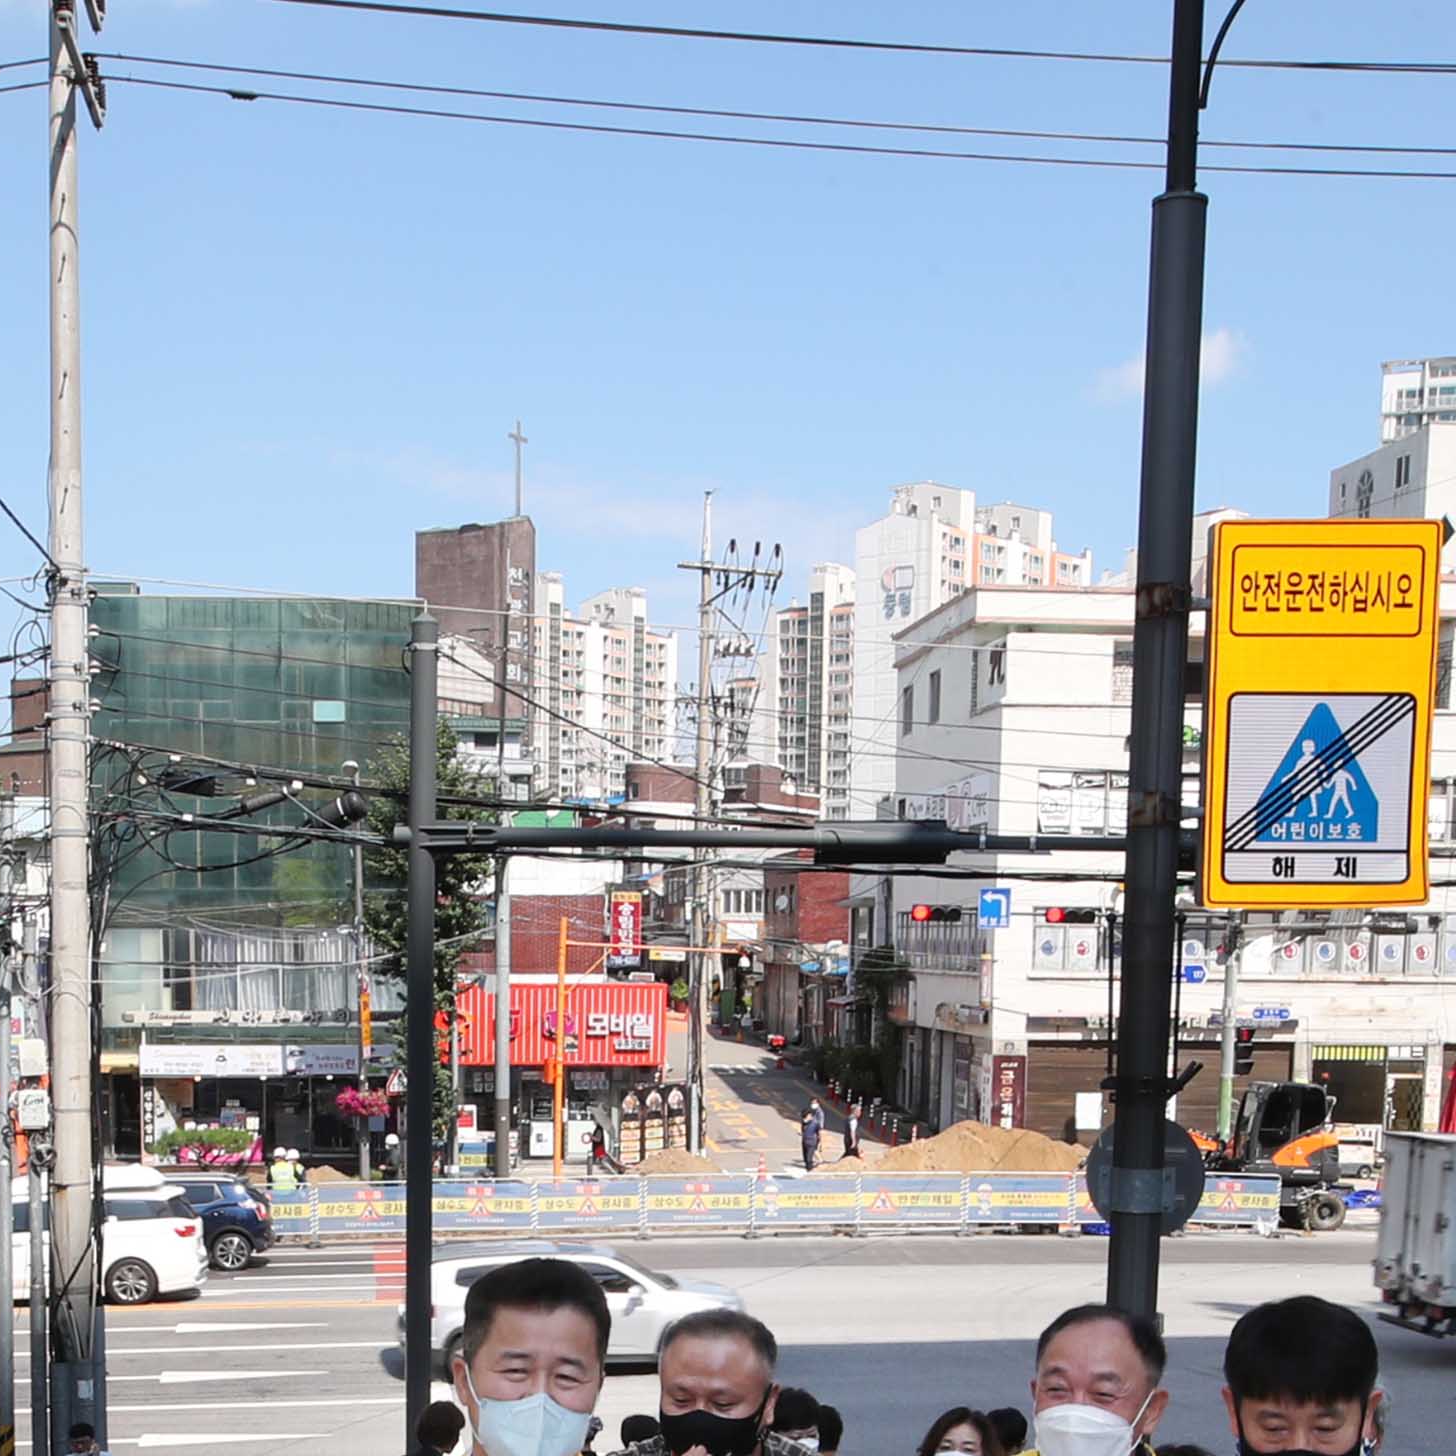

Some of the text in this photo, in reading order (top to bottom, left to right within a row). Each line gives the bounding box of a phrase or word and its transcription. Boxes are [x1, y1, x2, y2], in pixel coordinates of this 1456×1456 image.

[1240, 571, 1414, 613] 안전운전하십시오
[1271, 822, 1363, 840] 어린이보호
[587, 1013, 655, 1038] 모바일
[383, 1202, 406, 1214] 공사
